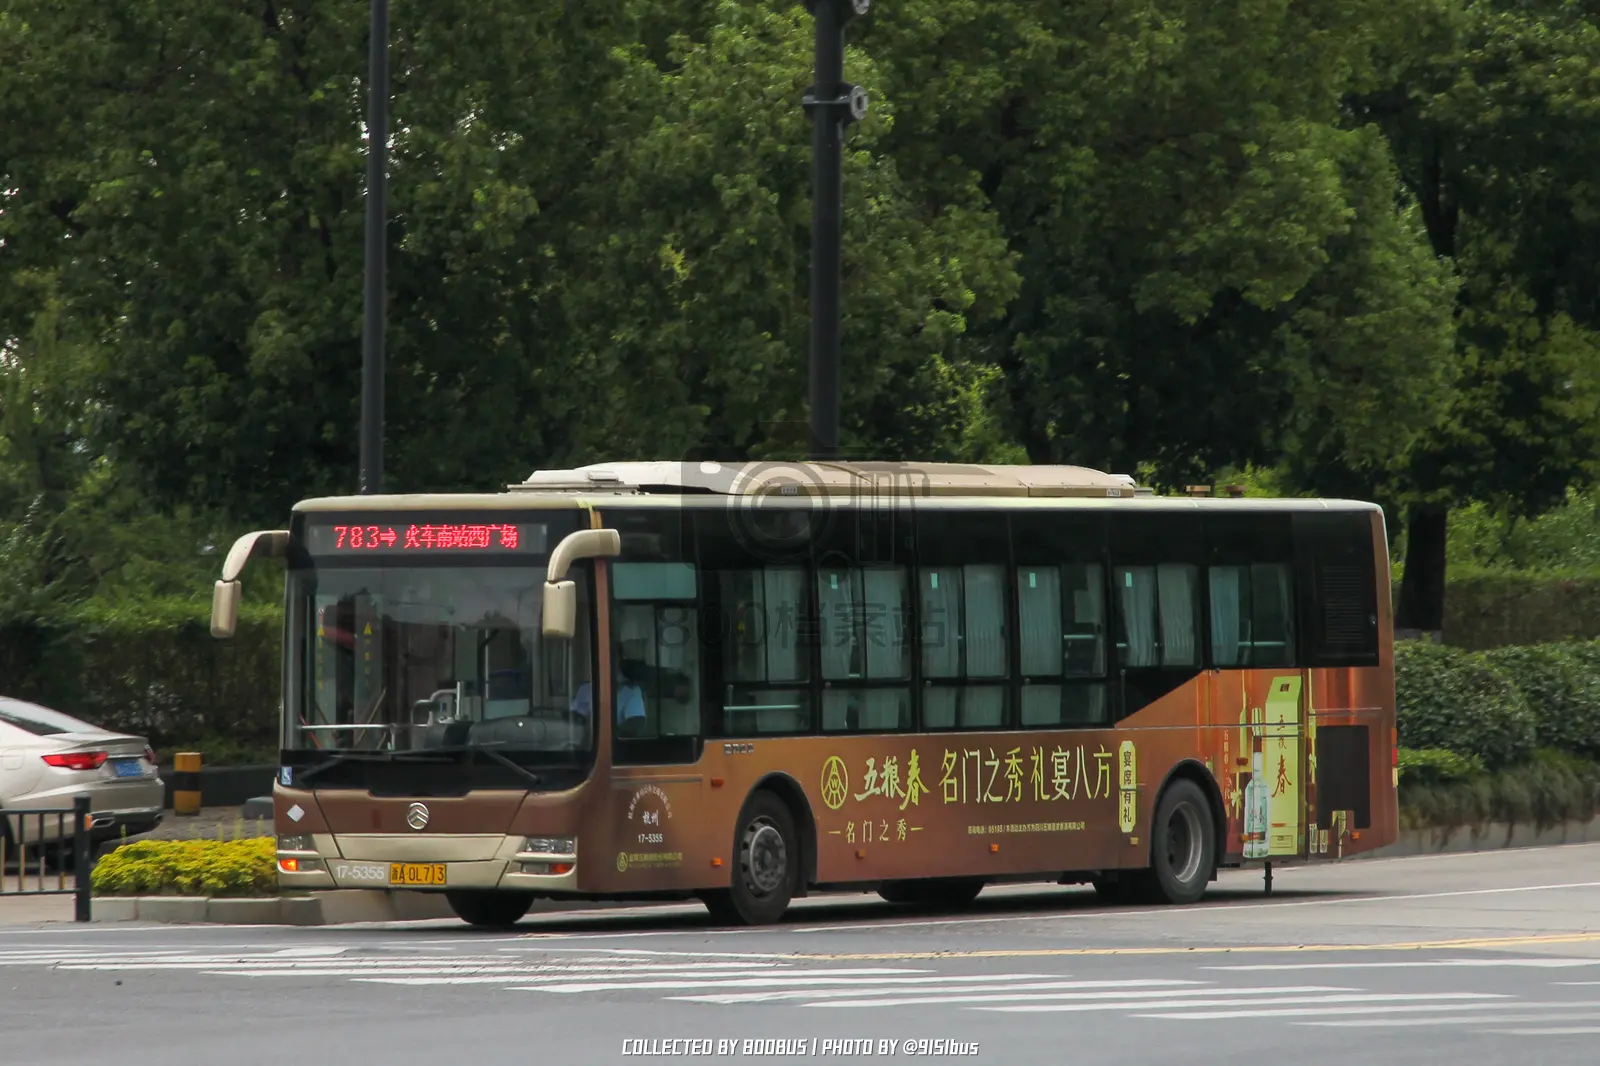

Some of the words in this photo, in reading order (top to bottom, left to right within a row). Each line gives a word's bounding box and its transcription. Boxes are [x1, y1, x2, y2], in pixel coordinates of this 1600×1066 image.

[334, 525, 379, 548] 783
[854, 749, 930, 811] 五粮春
[638, 833, 663, 843] 17-5355
[336, 864, 385, 880] 17-5355
